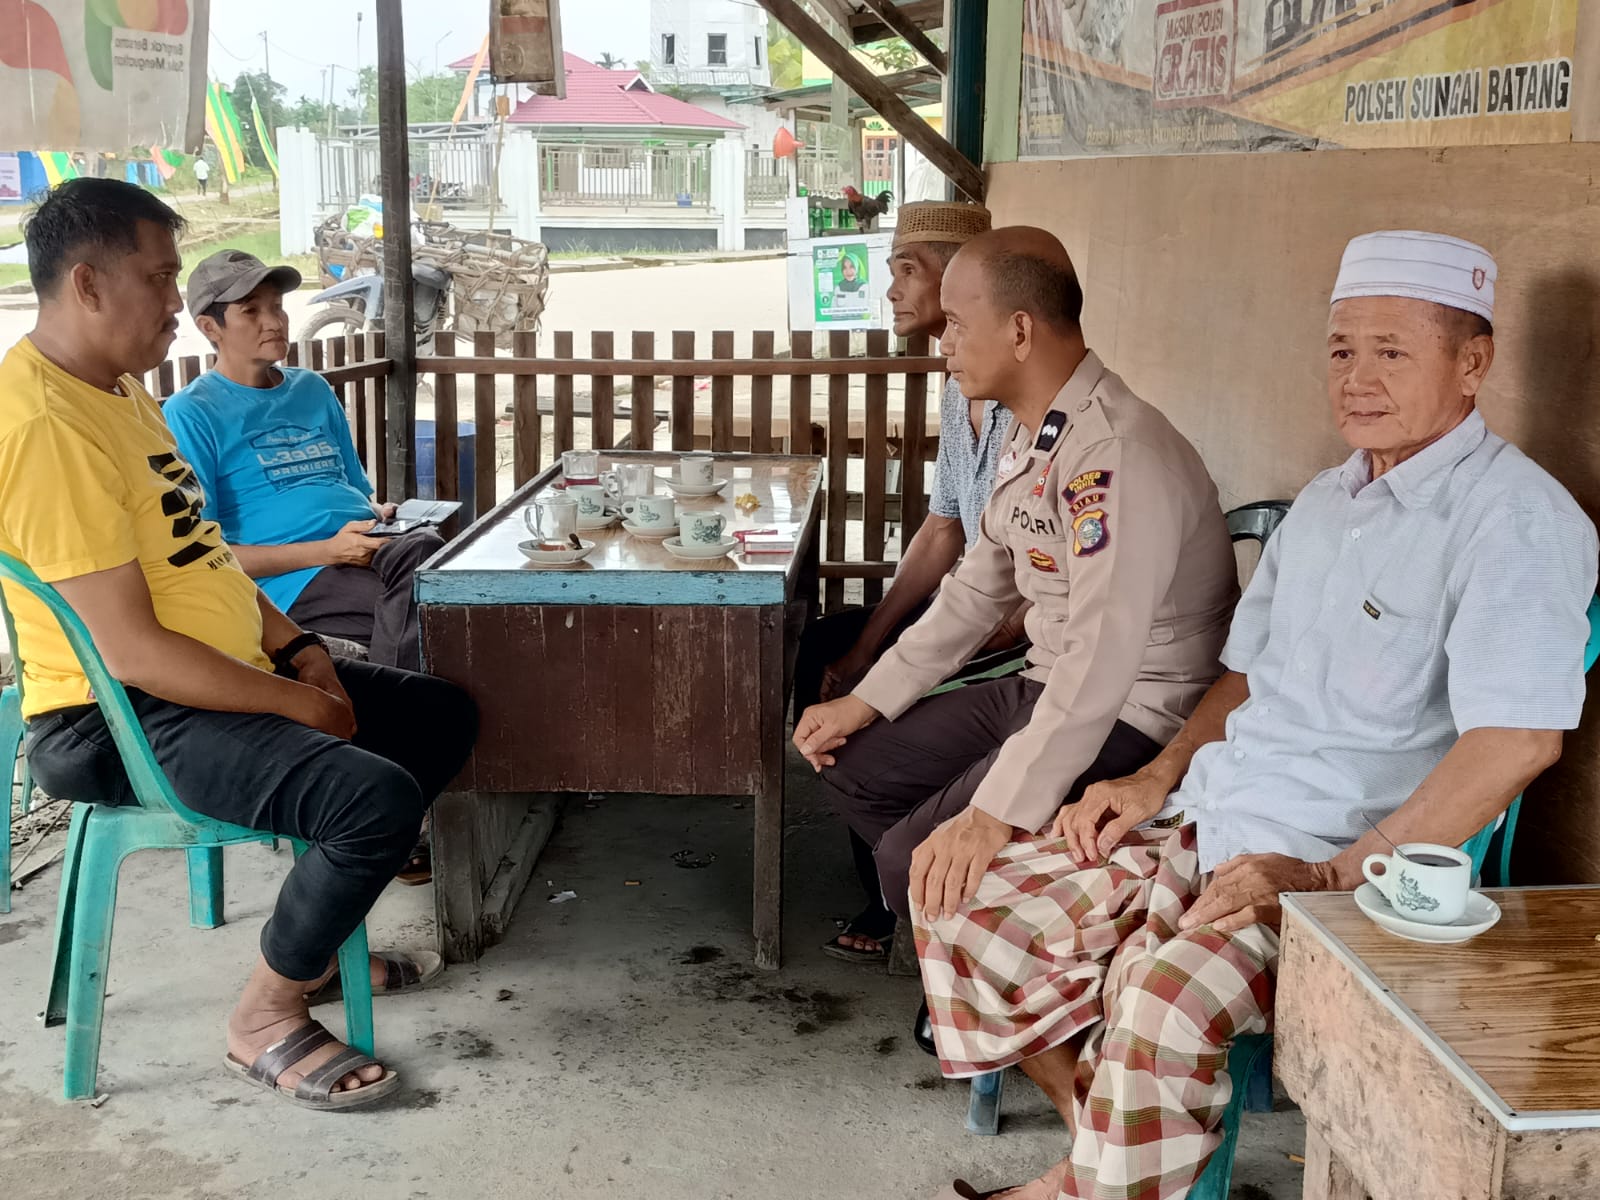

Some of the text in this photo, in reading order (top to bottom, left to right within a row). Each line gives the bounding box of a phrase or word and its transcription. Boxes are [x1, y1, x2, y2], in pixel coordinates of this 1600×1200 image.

[1166, 8, 1224, 39] MASUK POLISI
[1159, 35, 1228, 93] GRATIS
[1344, 60, 1571, 122] POLSEK SUNGAI BATANG
[1072, 494, 1099, 511] RIAU
[1011, 506, 1056, 535] POLRI
